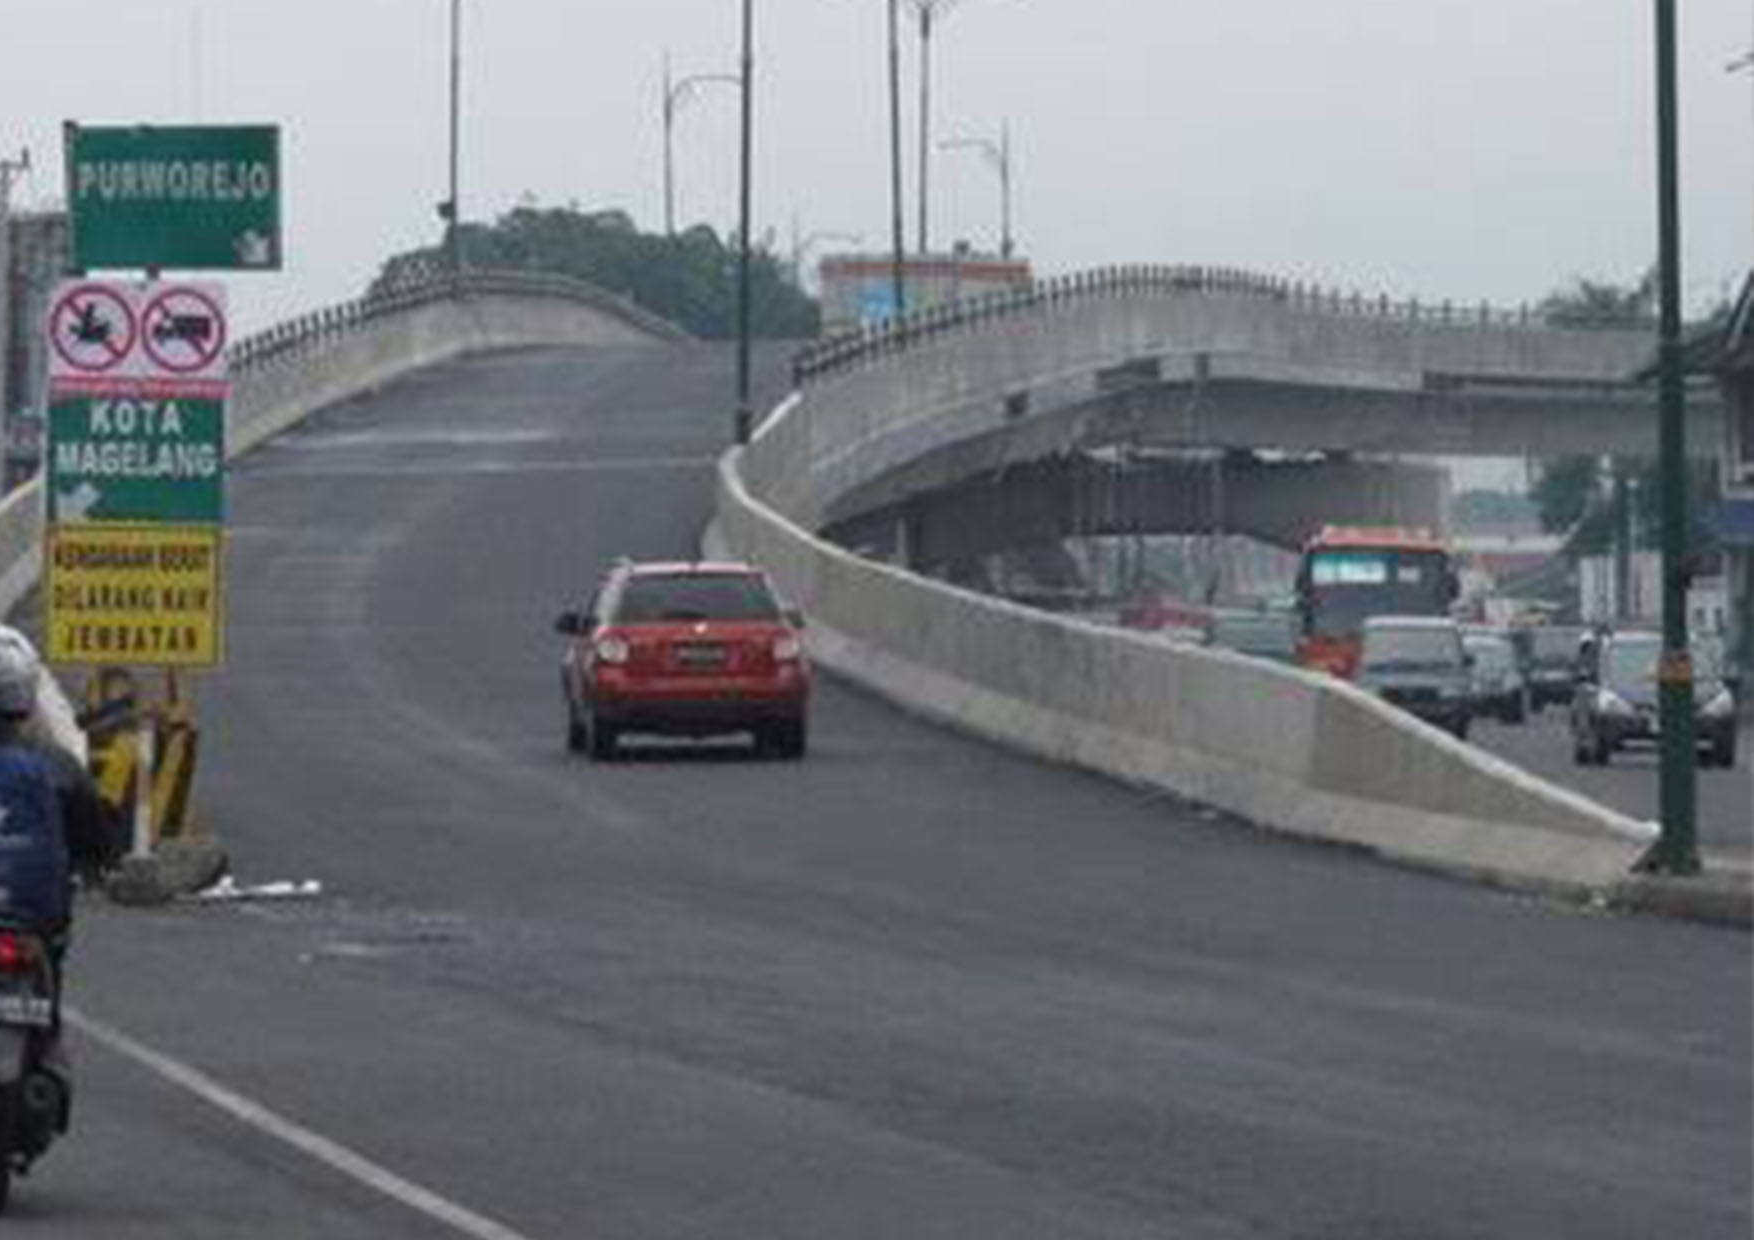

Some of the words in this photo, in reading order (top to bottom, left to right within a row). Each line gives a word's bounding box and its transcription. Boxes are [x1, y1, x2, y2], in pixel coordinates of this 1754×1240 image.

[77, 161, 270, 201] PURWOREJO
[90, 401, 182, 436] KOTA
[56, 441, 217, 479] MAGELANG
[66, 624, 197, 653] JEMBATAN
